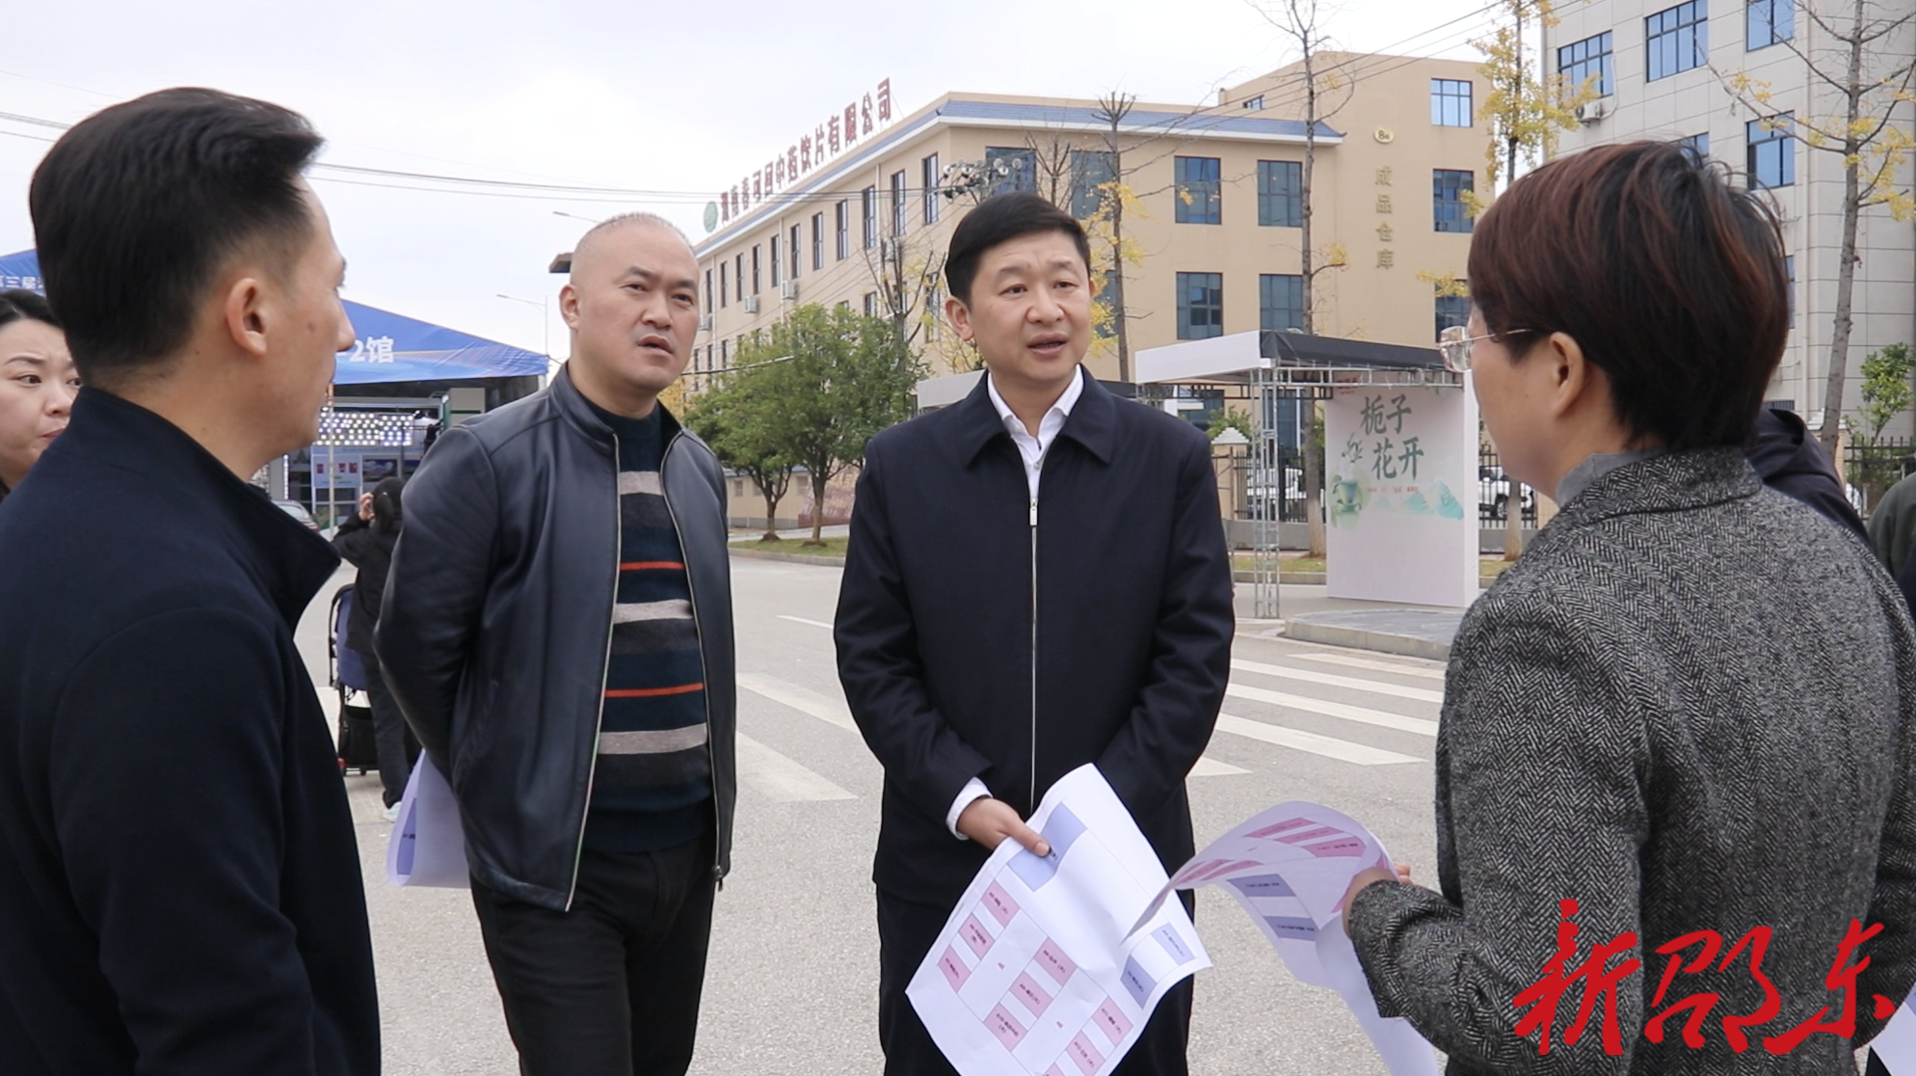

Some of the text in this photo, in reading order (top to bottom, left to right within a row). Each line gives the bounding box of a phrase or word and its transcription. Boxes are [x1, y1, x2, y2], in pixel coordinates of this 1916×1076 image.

[1375, 165, 1394, 270] 成品仓库
[1360, 394, 1412, 436] 栀子
[1371, 437, 1425, 481] 花开
